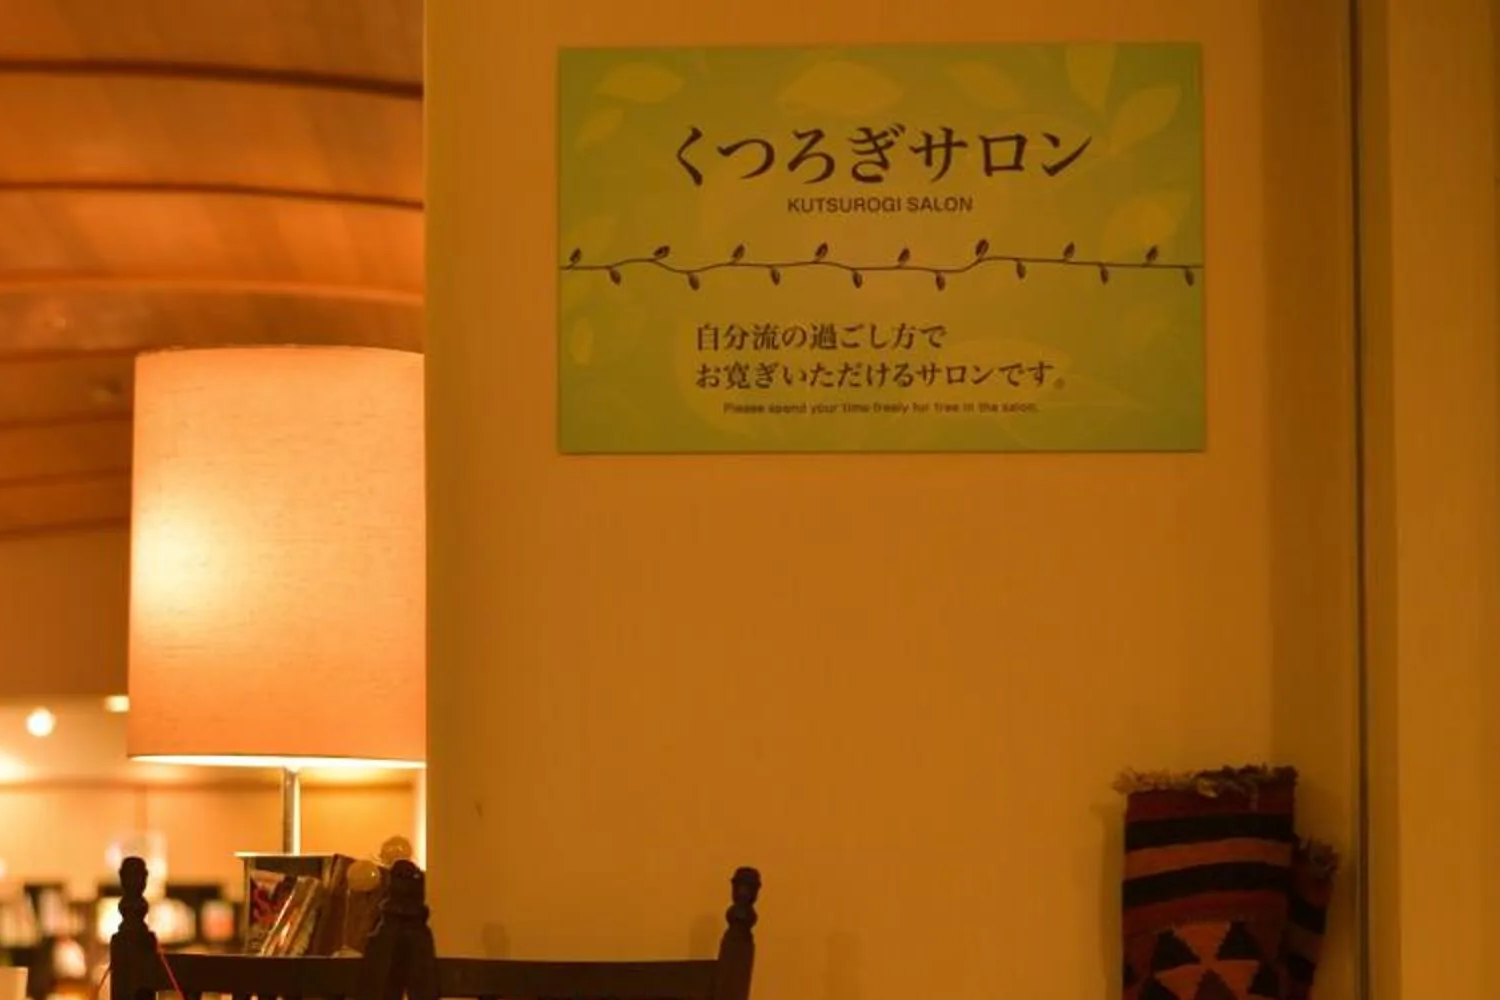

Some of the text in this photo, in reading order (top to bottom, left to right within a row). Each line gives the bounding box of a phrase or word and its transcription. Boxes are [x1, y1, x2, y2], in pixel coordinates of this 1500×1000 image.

[676, 124, 1092, 186] くつろぎサロン
[787, 197, 973, 213] KUTSUROGI SALON
[696, 322, 947, 351] 自分流の過ごし方で
[695, 360, 1066, 390] お寛ぎいただけるサロンです。
[723, 402, 765, 413] Please
[768, 402, 807, 414] spend
[810, 403, 840, 415] your
